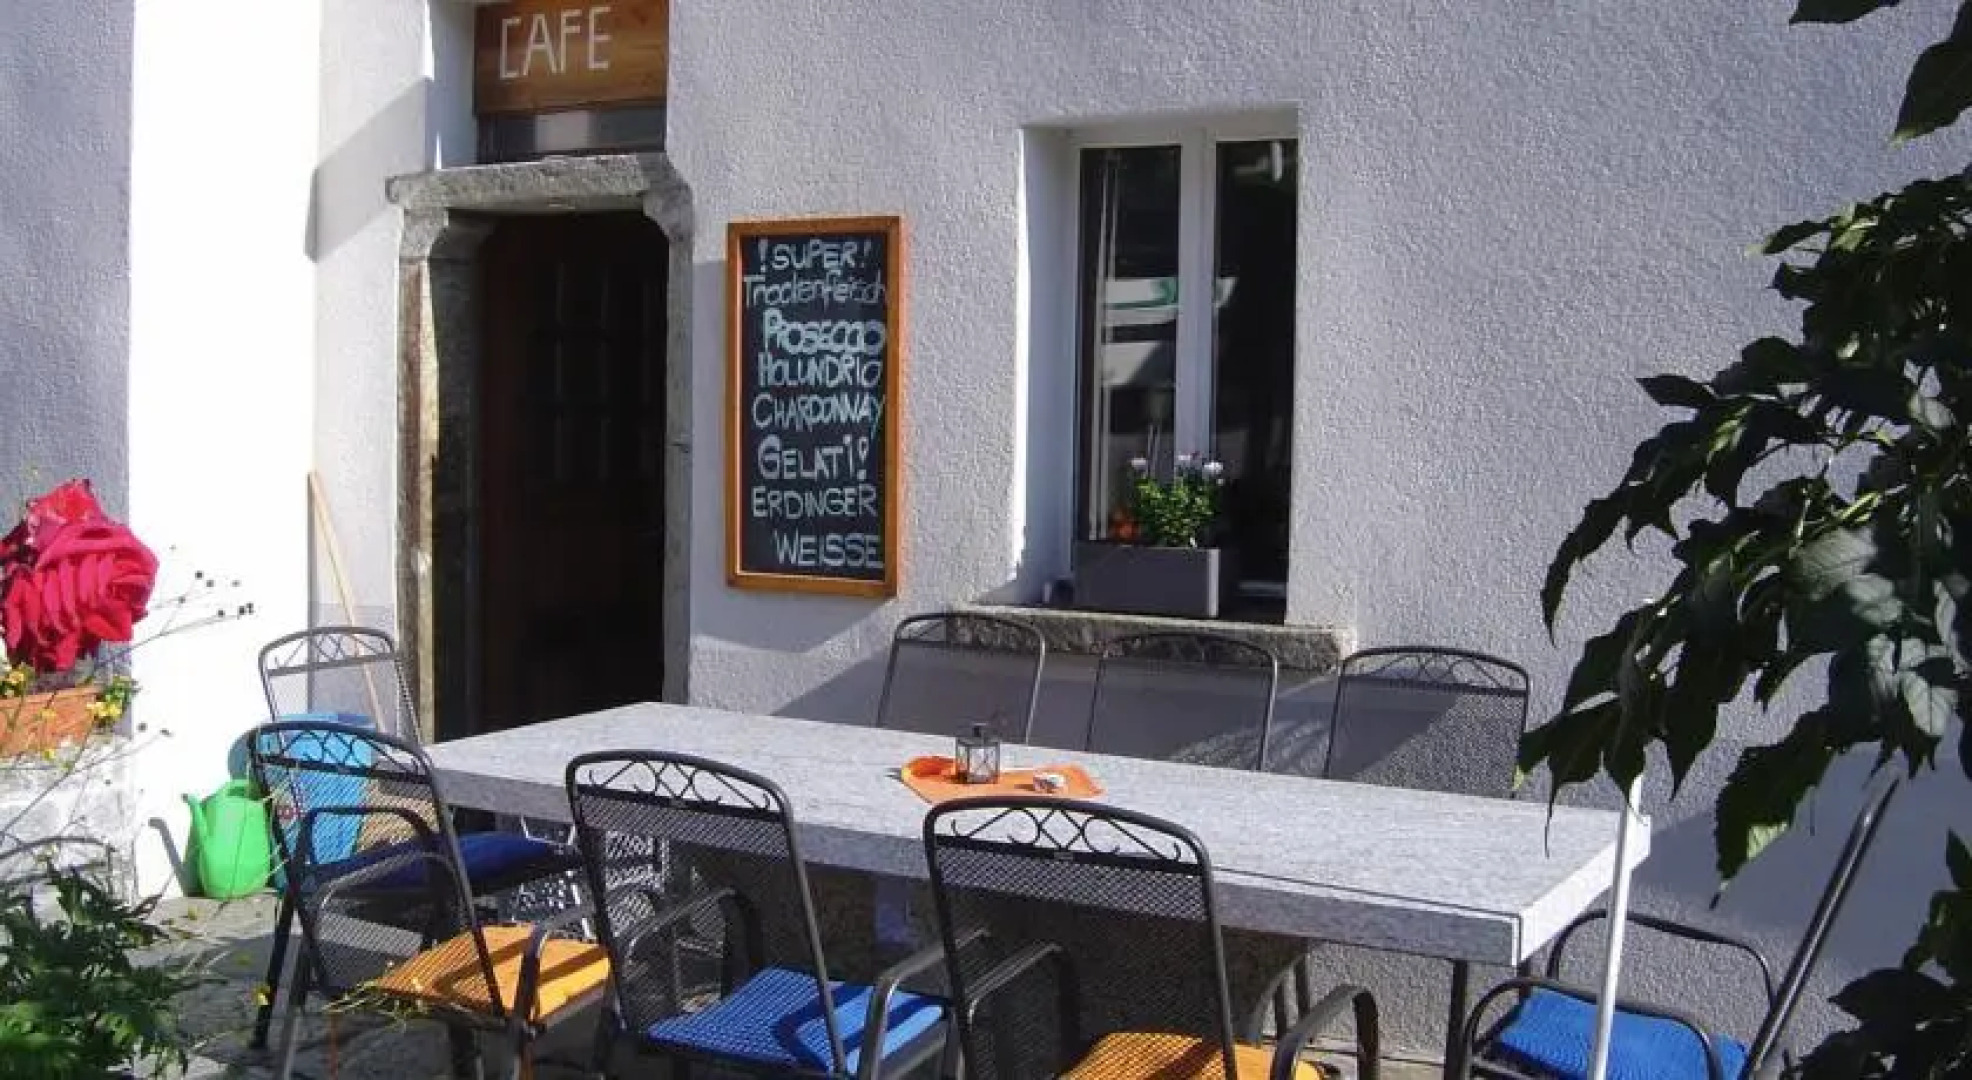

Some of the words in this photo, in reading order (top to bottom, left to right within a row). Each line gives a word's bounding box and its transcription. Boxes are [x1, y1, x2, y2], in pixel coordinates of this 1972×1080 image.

[501, 6, 612, 79] CAFE
[752, 484, 877, 519] ERDINGER
[774, 528, 884, 568] WEISSE
